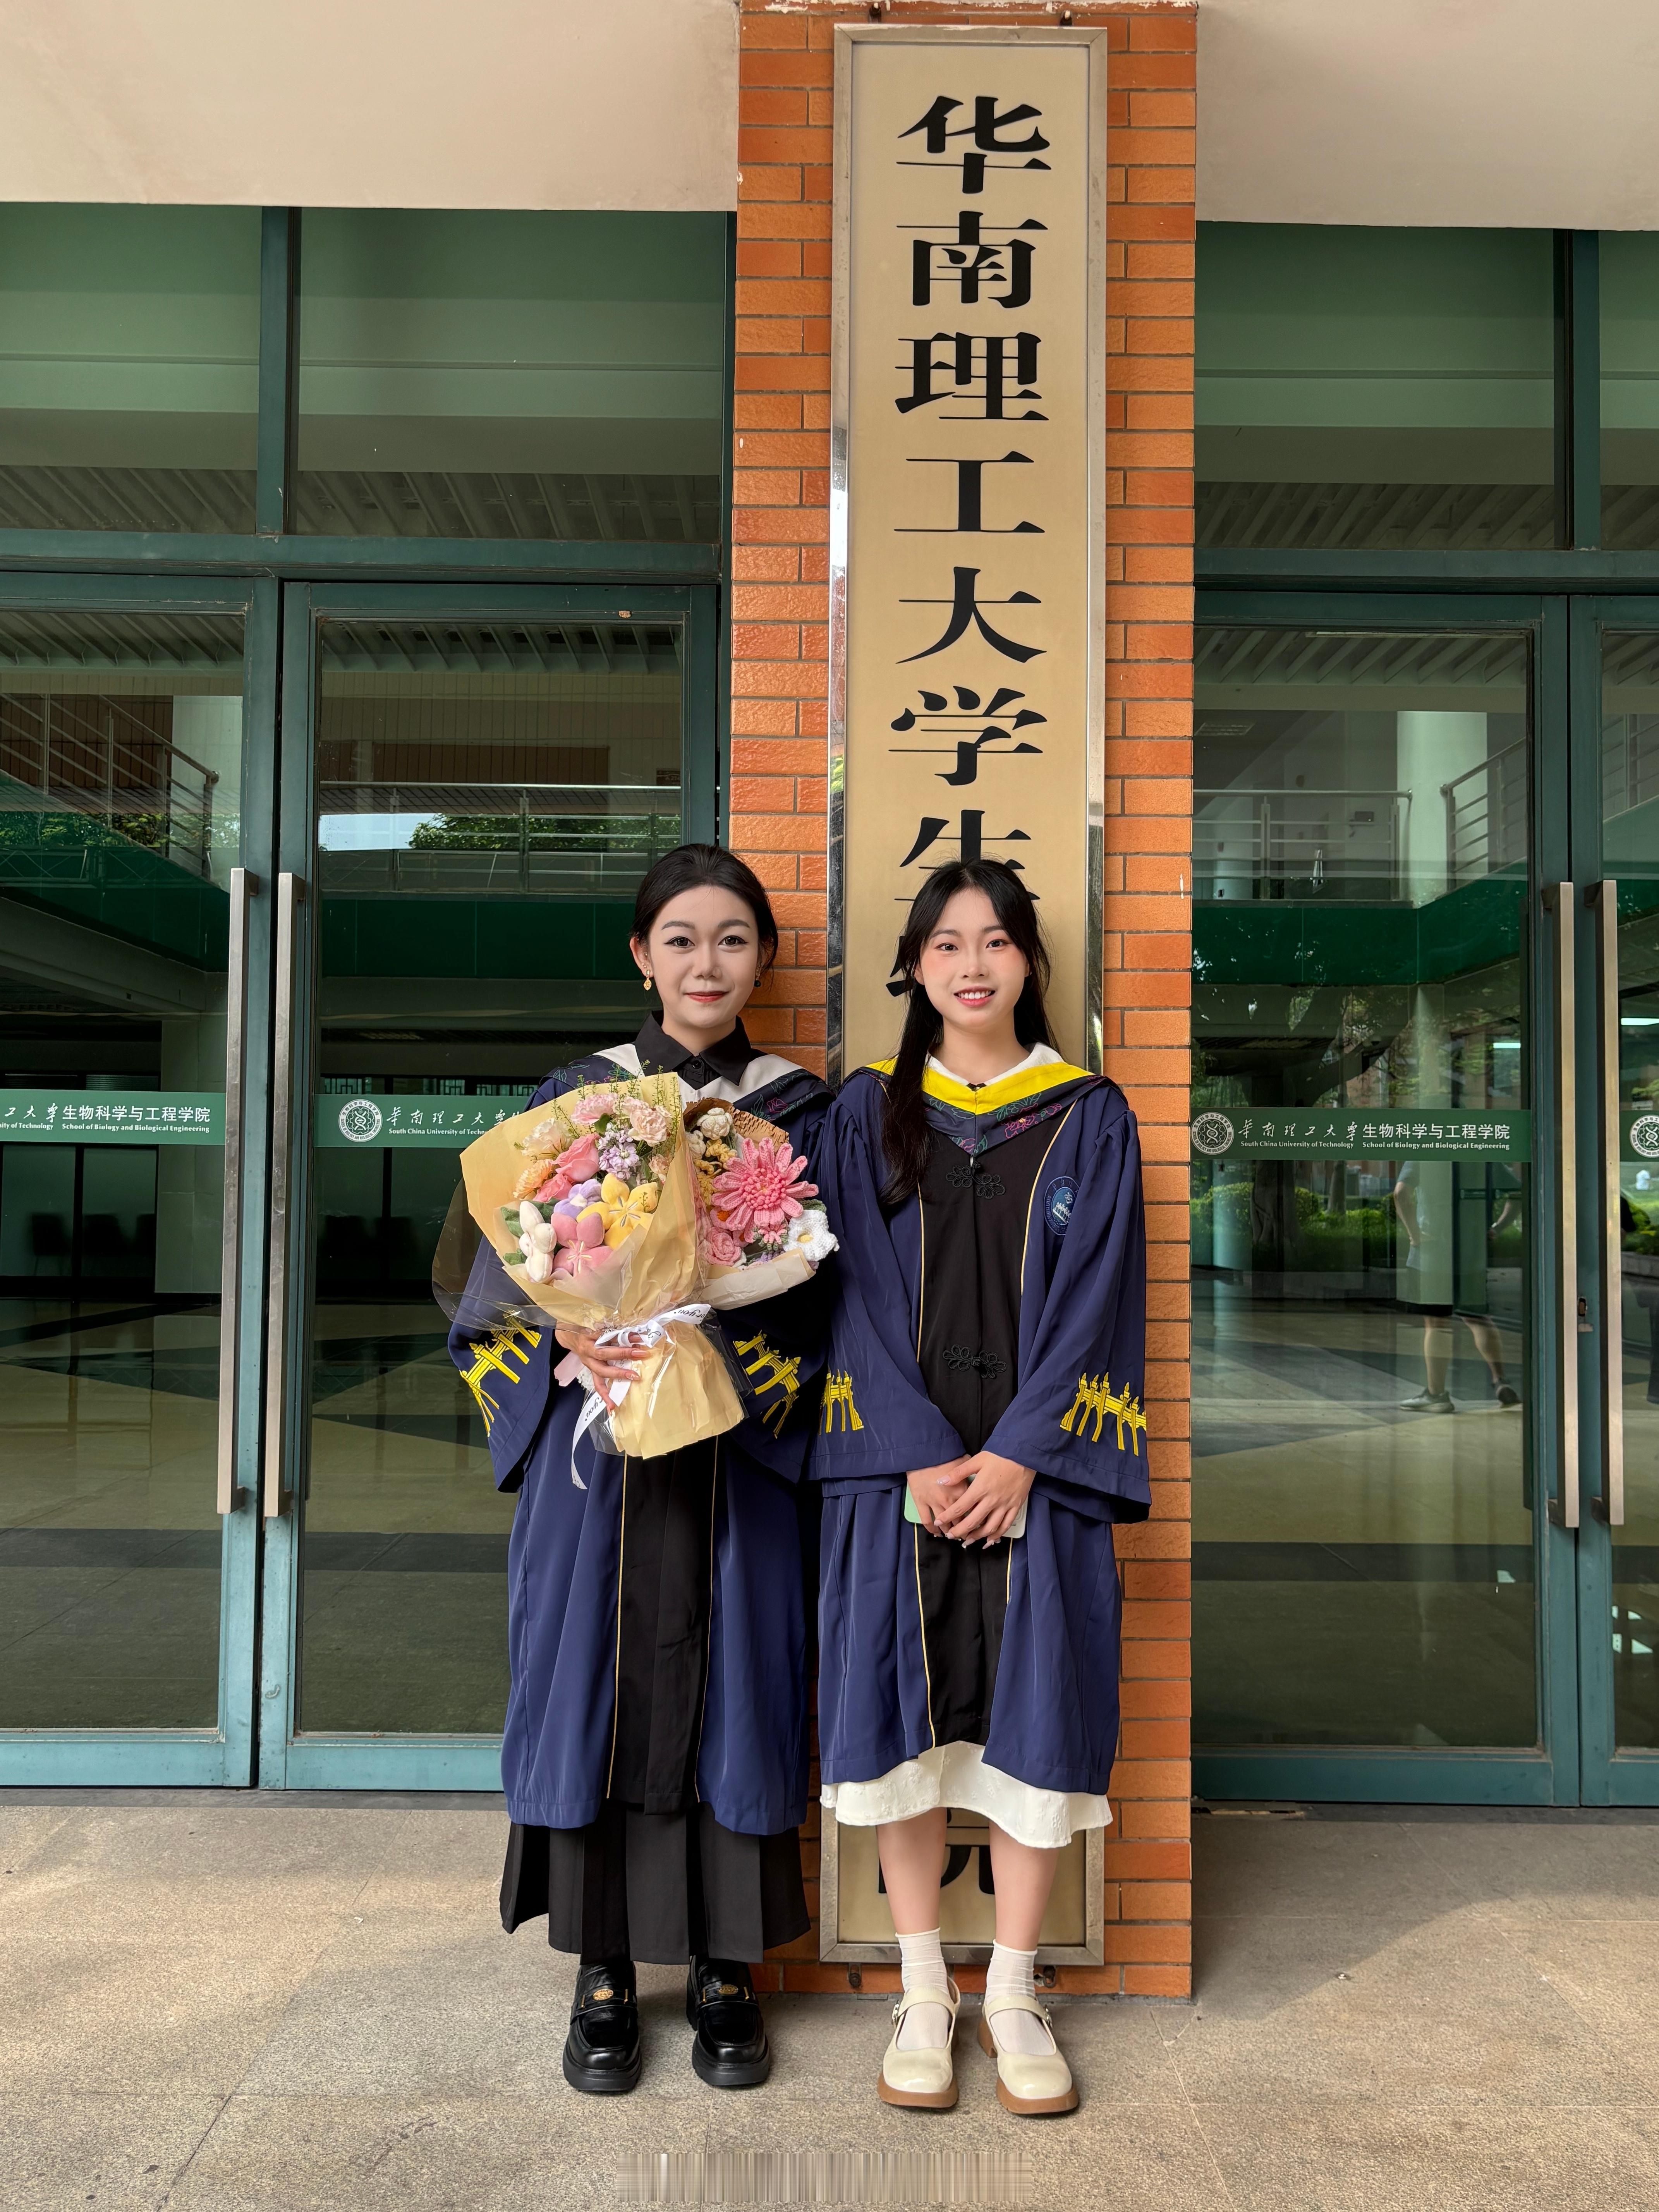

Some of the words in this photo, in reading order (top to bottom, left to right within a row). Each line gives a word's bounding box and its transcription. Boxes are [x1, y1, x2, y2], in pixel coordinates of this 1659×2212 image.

[886, 96, 1052, 997] 华南理工大学生
[62, 1105, 210, 1122] 生物科学与工程学院
[1363, 1123, 1510, 1139] 生物科学与工程学院
